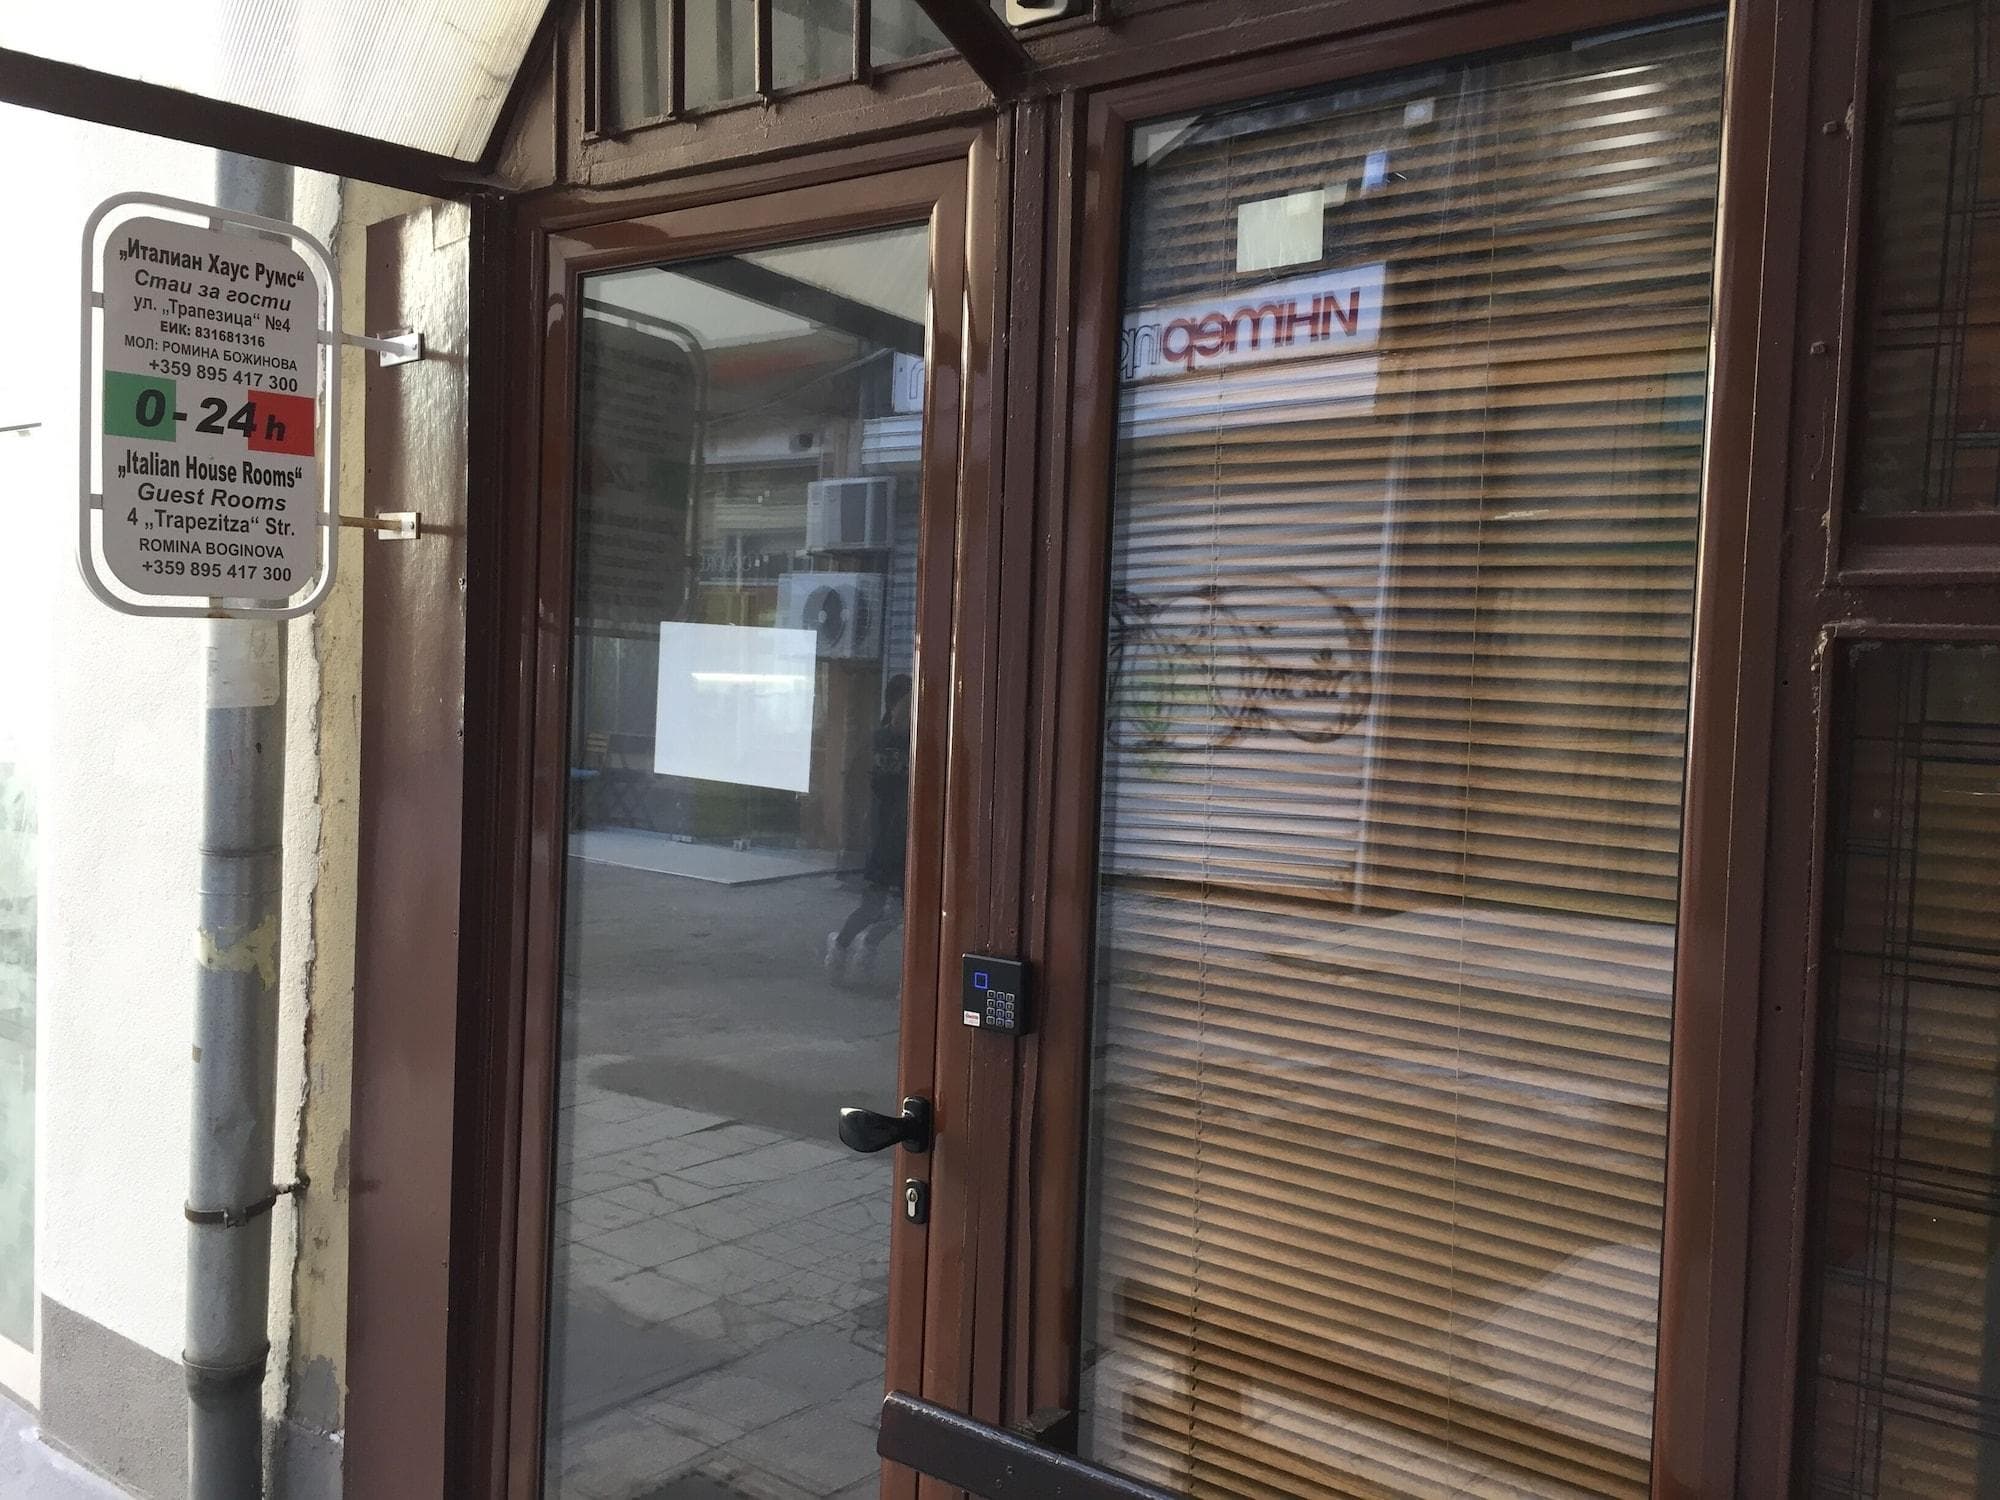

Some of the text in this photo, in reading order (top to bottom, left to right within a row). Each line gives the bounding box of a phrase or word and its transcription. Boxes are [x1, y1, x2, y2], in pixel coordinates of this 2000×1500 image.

[208, 253, 249, 282] Хаус
[135, 268, 292, 312] Стаи за гости
[133, 296, 157, 312] ул.
[265, 314, 291, 333] №4
[160, 320, 265, 348] ЕИК: 831681316
[124, 334, 298, 371] МОЛ: РОМИНА БОЖИНОВА
[149, 359, 298, 392] +359 895 417 300
[186, 455, 237, 483] House
[138, 482, 287, 511] Guest Rooms
[127, 507, 138, 526] 4
[265, 517, 295, 536] Str.
[139, 538, 284, 559] ROMINA BOGINOVA
[142, 559, 292, 582] +359 895 417 300
